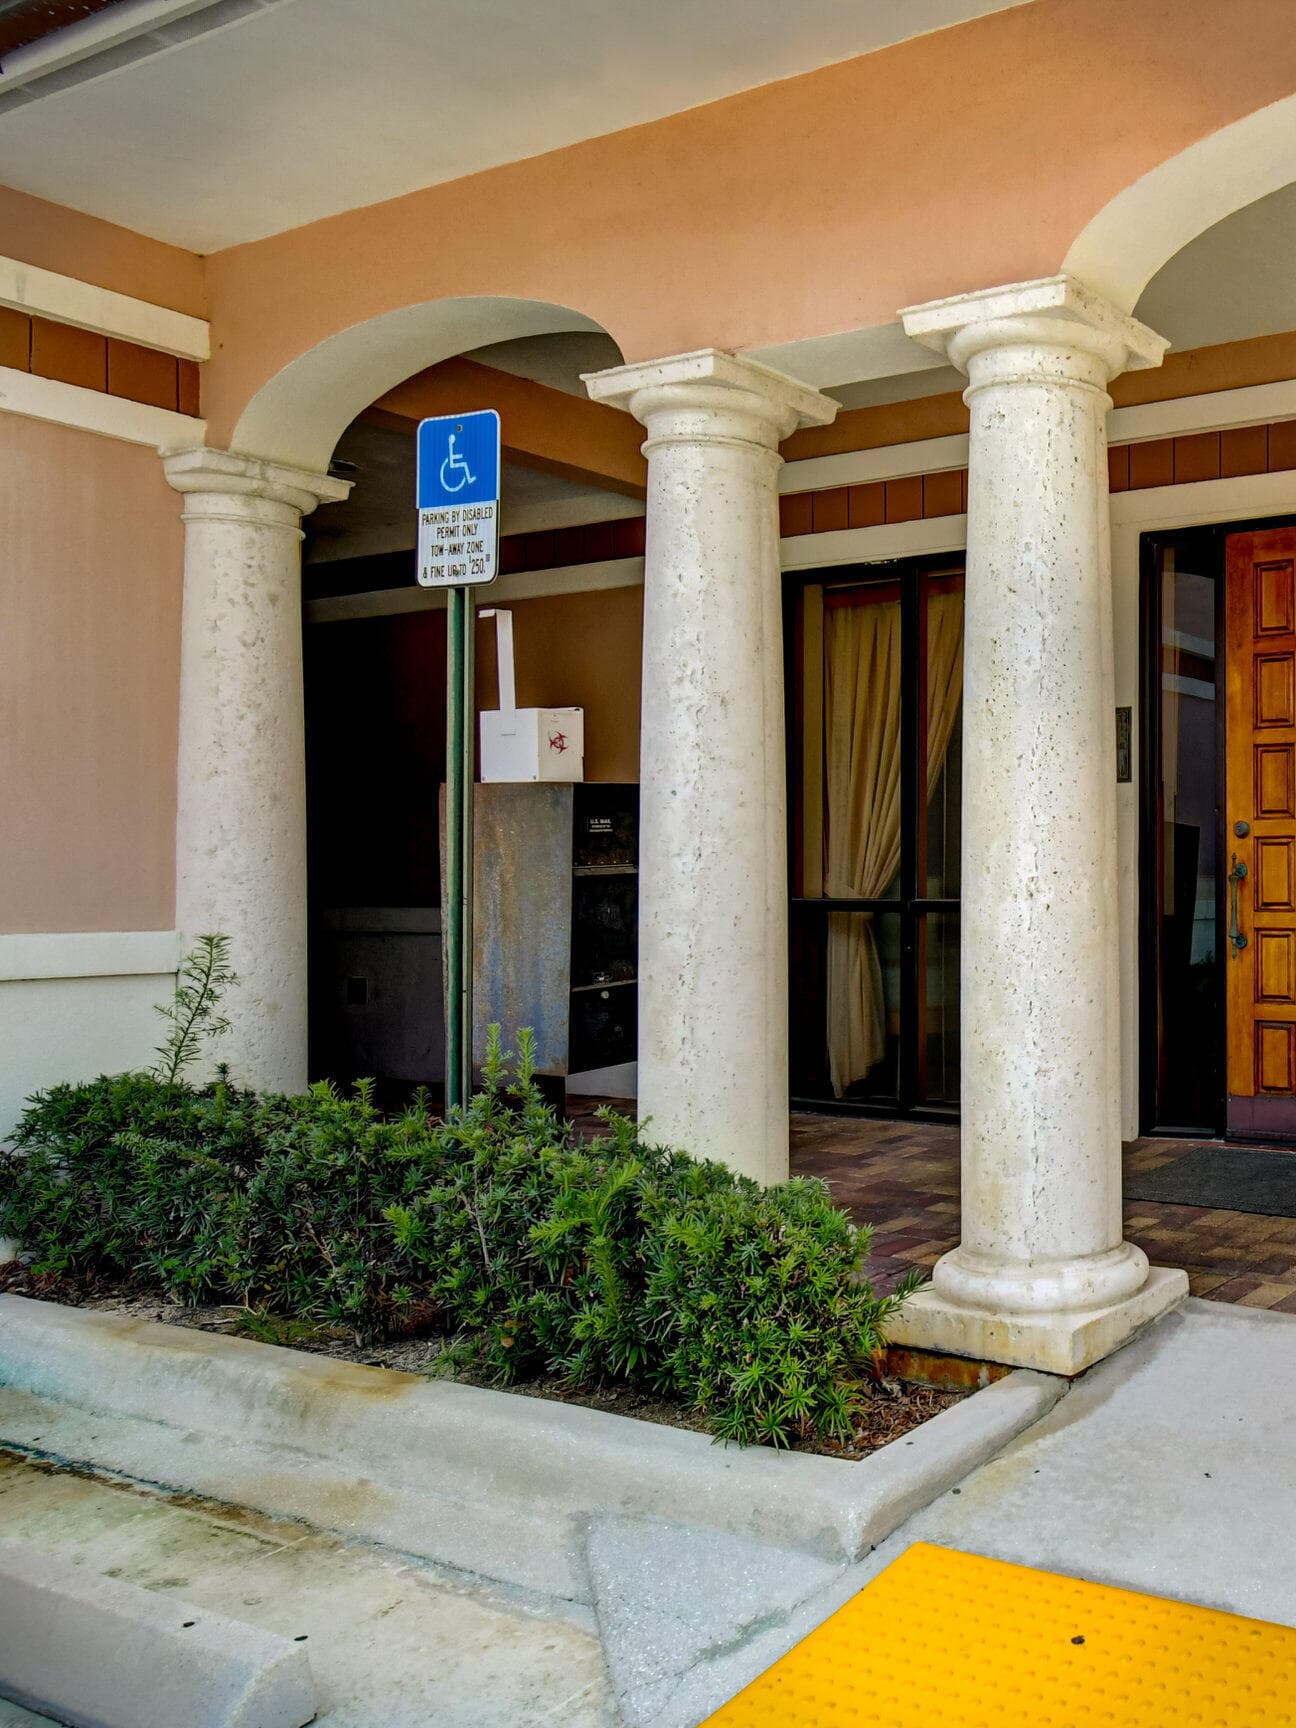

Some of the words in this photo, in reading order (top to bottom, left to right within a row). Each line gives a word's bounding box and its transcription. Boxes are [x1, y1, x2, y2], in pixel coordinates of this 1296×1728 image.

[422, 511, 449, 526] PARKING
[451, 510, 460, 522] BY
[462, 506, 493, 522] DISABLED
[436, 525, 460, 539] PERMIT
[462, 523, 478, 537] ONLY
[431, 543, 464, 557] TOW-AWAY
[466, 540, 484, 553] ZONE
[430, 565, 445, 578] FINE
[447, 564, 457, 577] UP
[459, 563, 467, 576] TO
